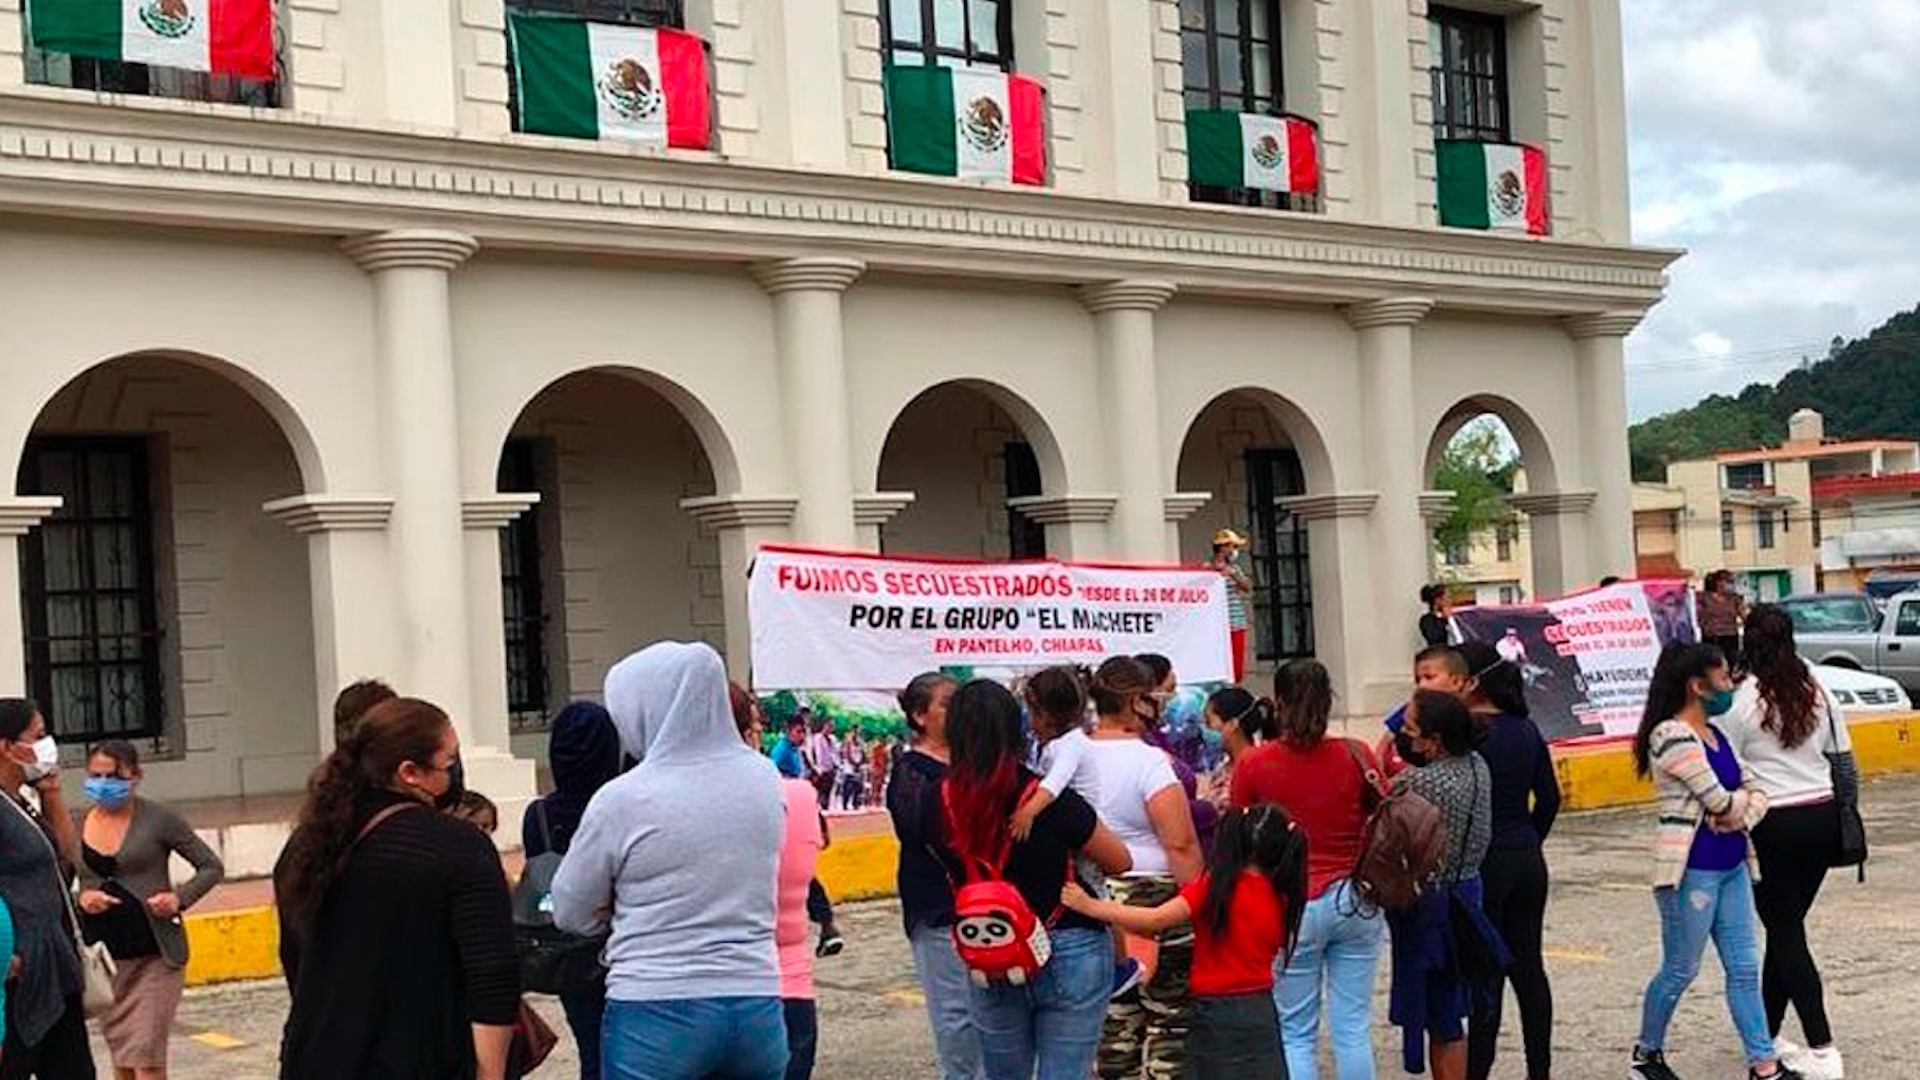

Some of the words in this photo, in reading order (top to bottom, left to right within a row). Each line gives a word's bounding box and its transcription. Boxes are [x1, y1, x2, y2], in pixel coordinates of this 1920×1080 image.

[778, 565, 879, 593] FUIMOS
[884, 572, 1073, 597] SECUESTRADOS
[1125, 587, 1139, 602] EL
[850, 604, 904, 629] POR
[910, 607, 937, 630] EL
[944, 607, 1020, 630] GRUPO
[934, 638, 955, 653] EN
[1041, 638, 1104, 652] CHIAPAS
